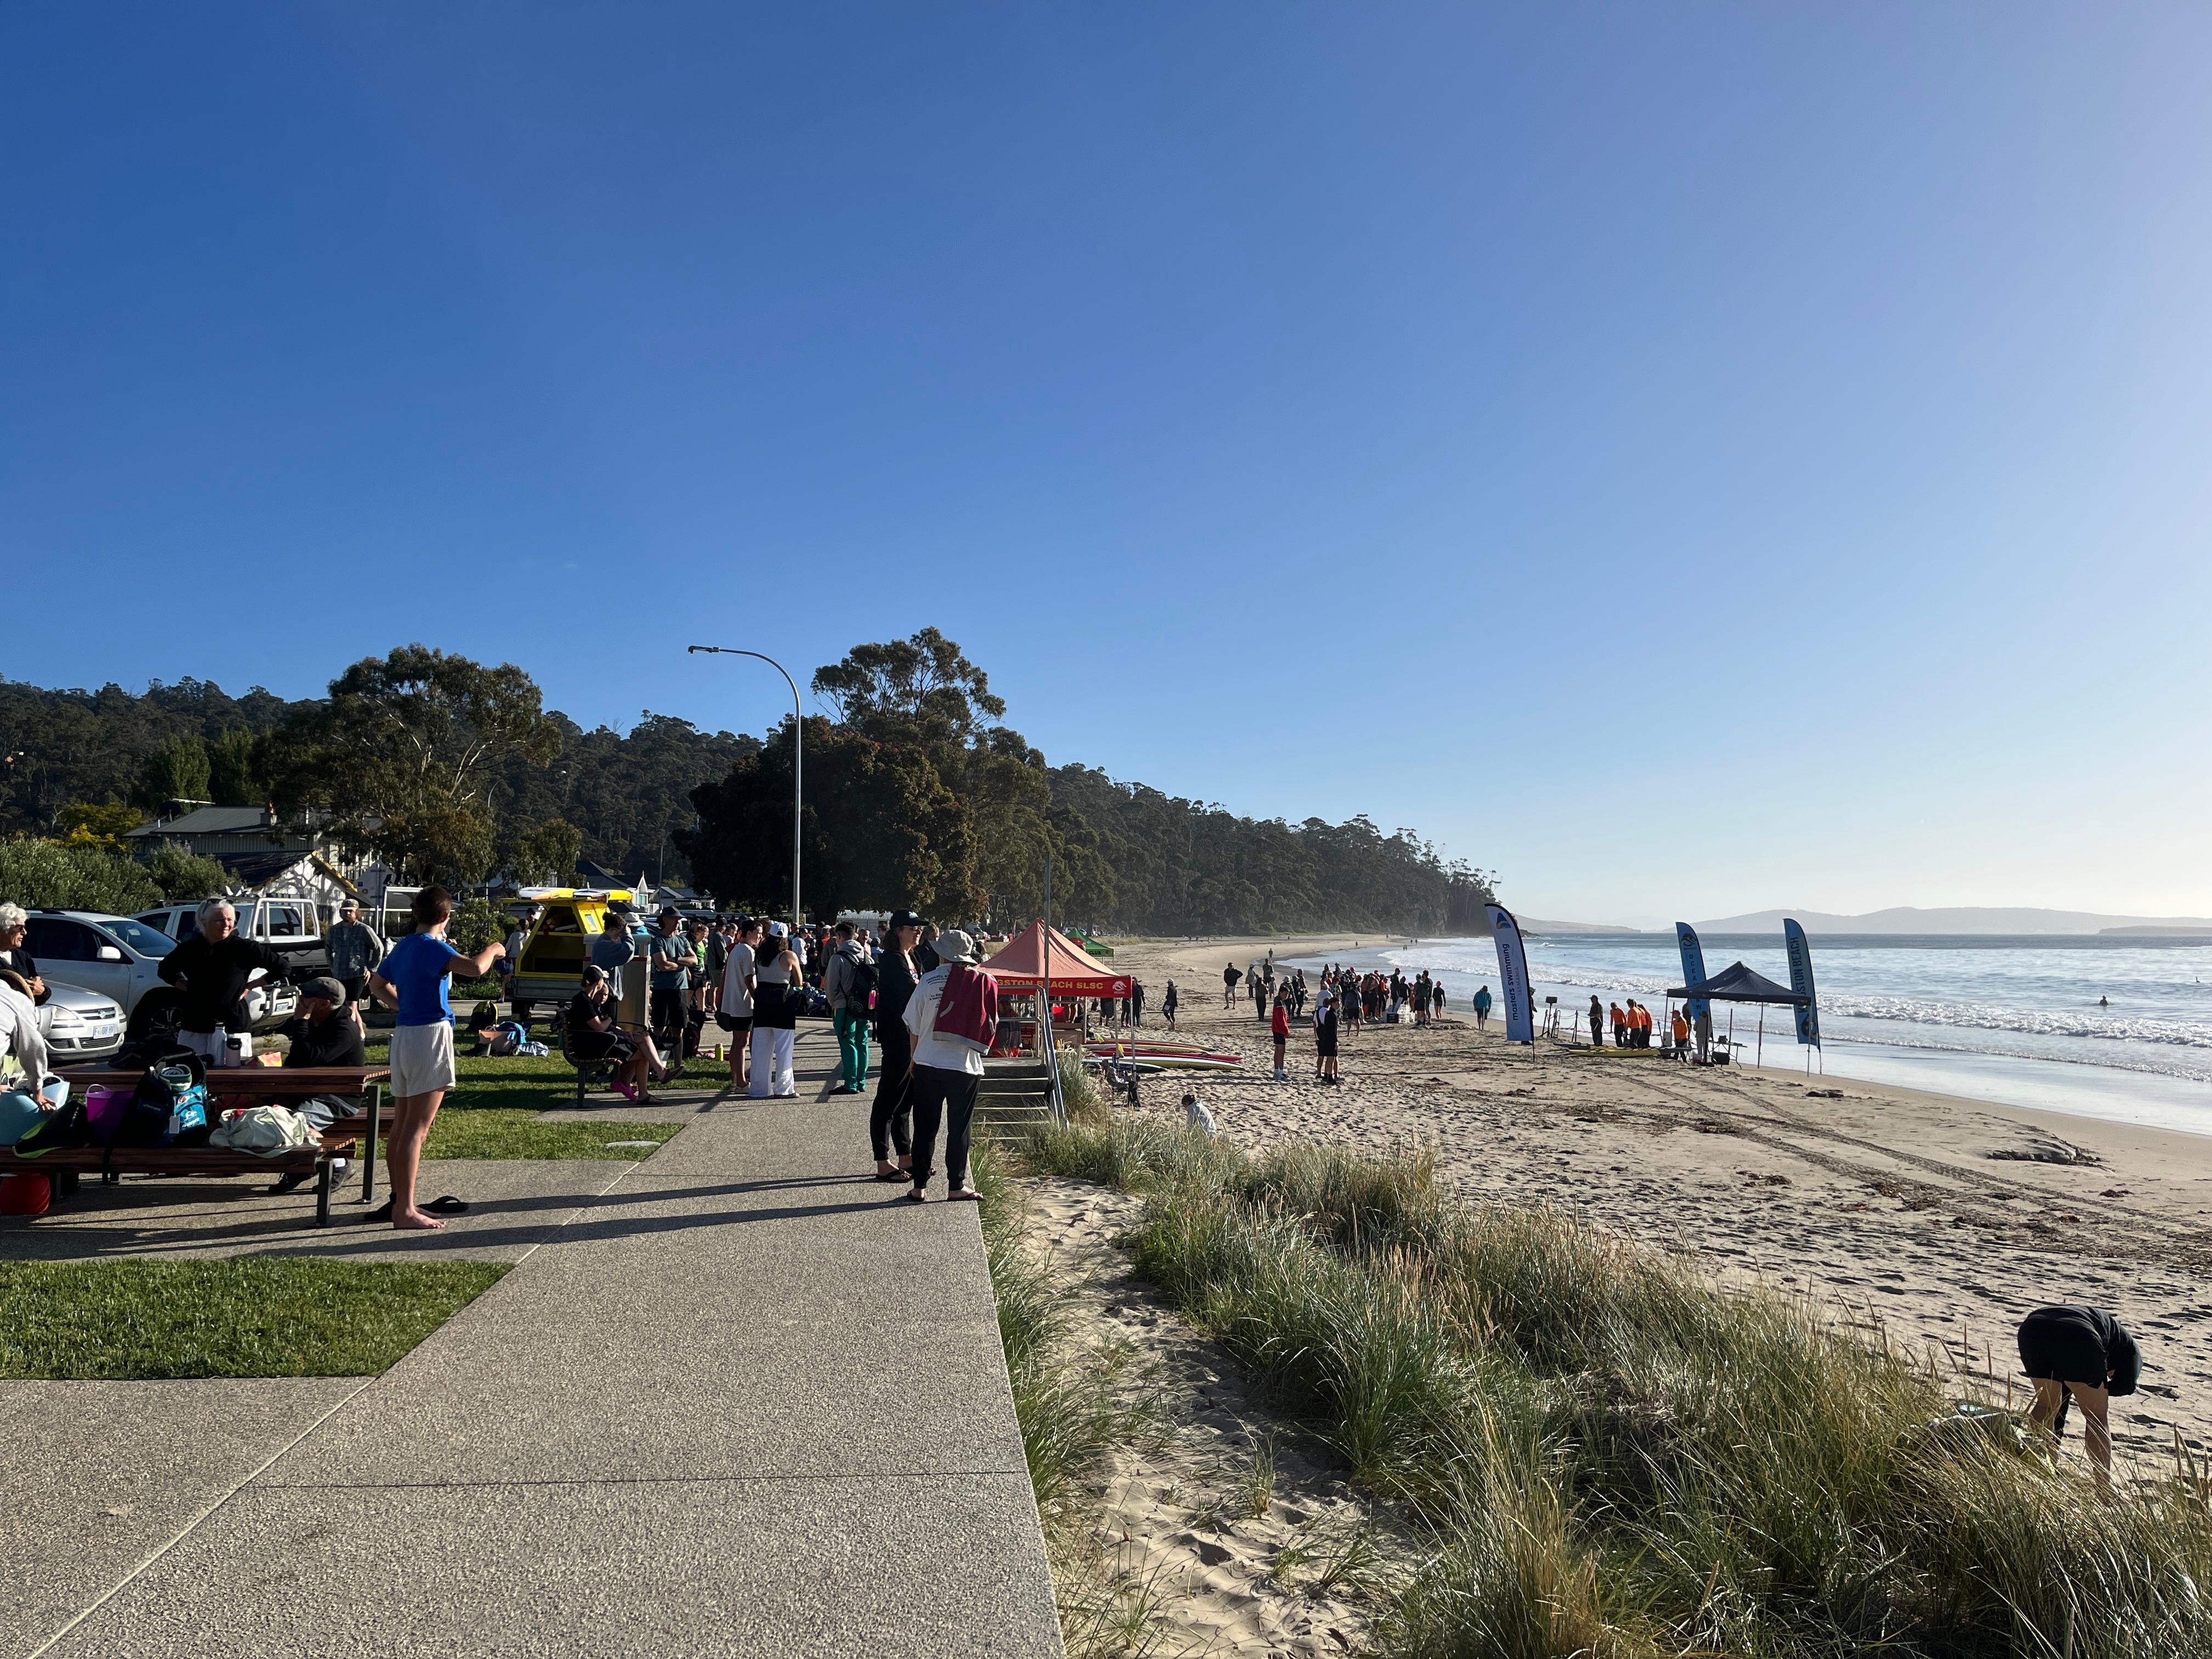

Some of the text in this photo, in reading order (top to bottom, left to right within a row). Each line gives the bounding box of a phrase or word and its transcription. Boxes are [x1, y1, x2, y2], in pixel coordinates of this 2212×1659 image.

[1791, 937, 1802, 966] BEACH
[1037, 980, 1073, 989] BACH
[1502, 944, 1519, 1020] masters swimming
[1514, 967, 1522, 995] TASMANIA
